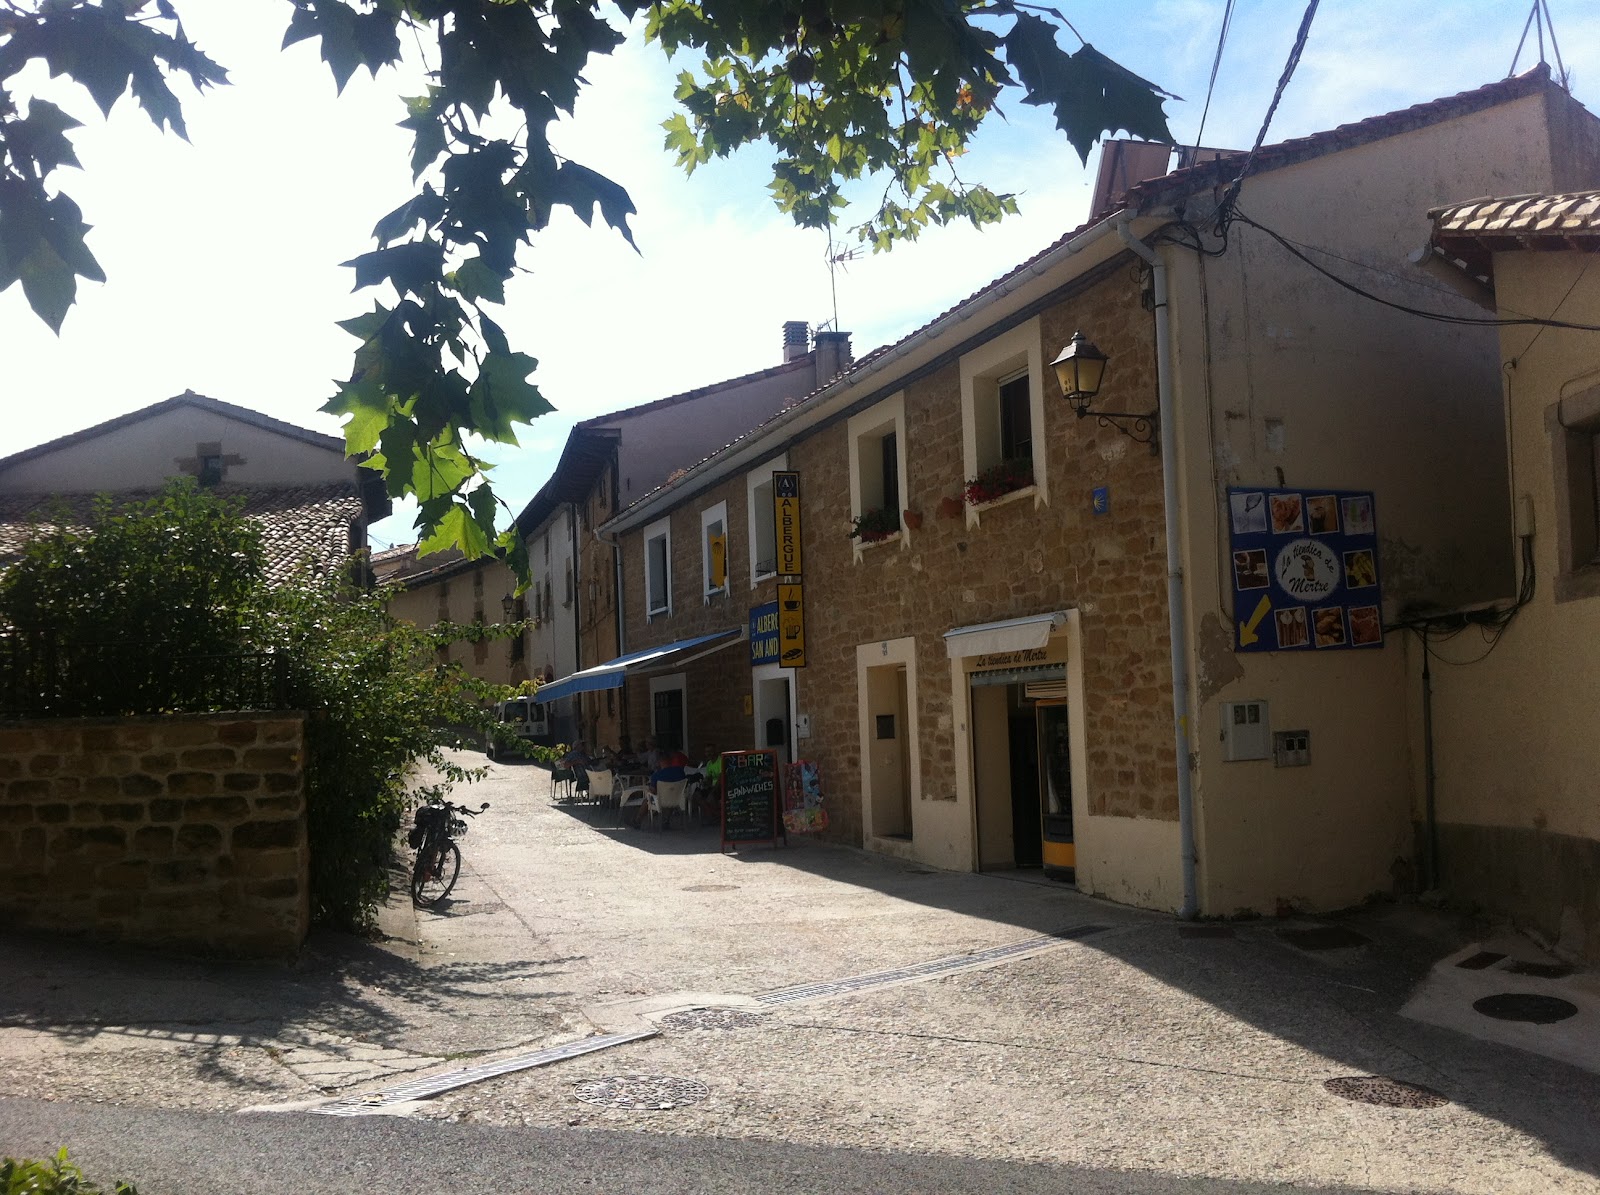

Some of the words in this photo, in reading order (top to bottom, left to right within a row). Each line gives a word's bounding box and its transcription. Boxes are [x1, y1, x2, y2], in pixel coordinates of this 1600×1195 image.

[781, 478, 790, 488] A
[781, 498, 794, 572] ALBERGUE
[1281, 555, 1291, 579] La
[1324, 558, 1334, 574] de
[1288, 577, 1329, 593] Mertxe
[751, 639, 764, 660] SAN
[976, 654, 985, 667] La
[1013, 651, 1022, 663] de
[736, 753, 764, 768] BAR
[727, 781, 774, 800] SANDWICHES
